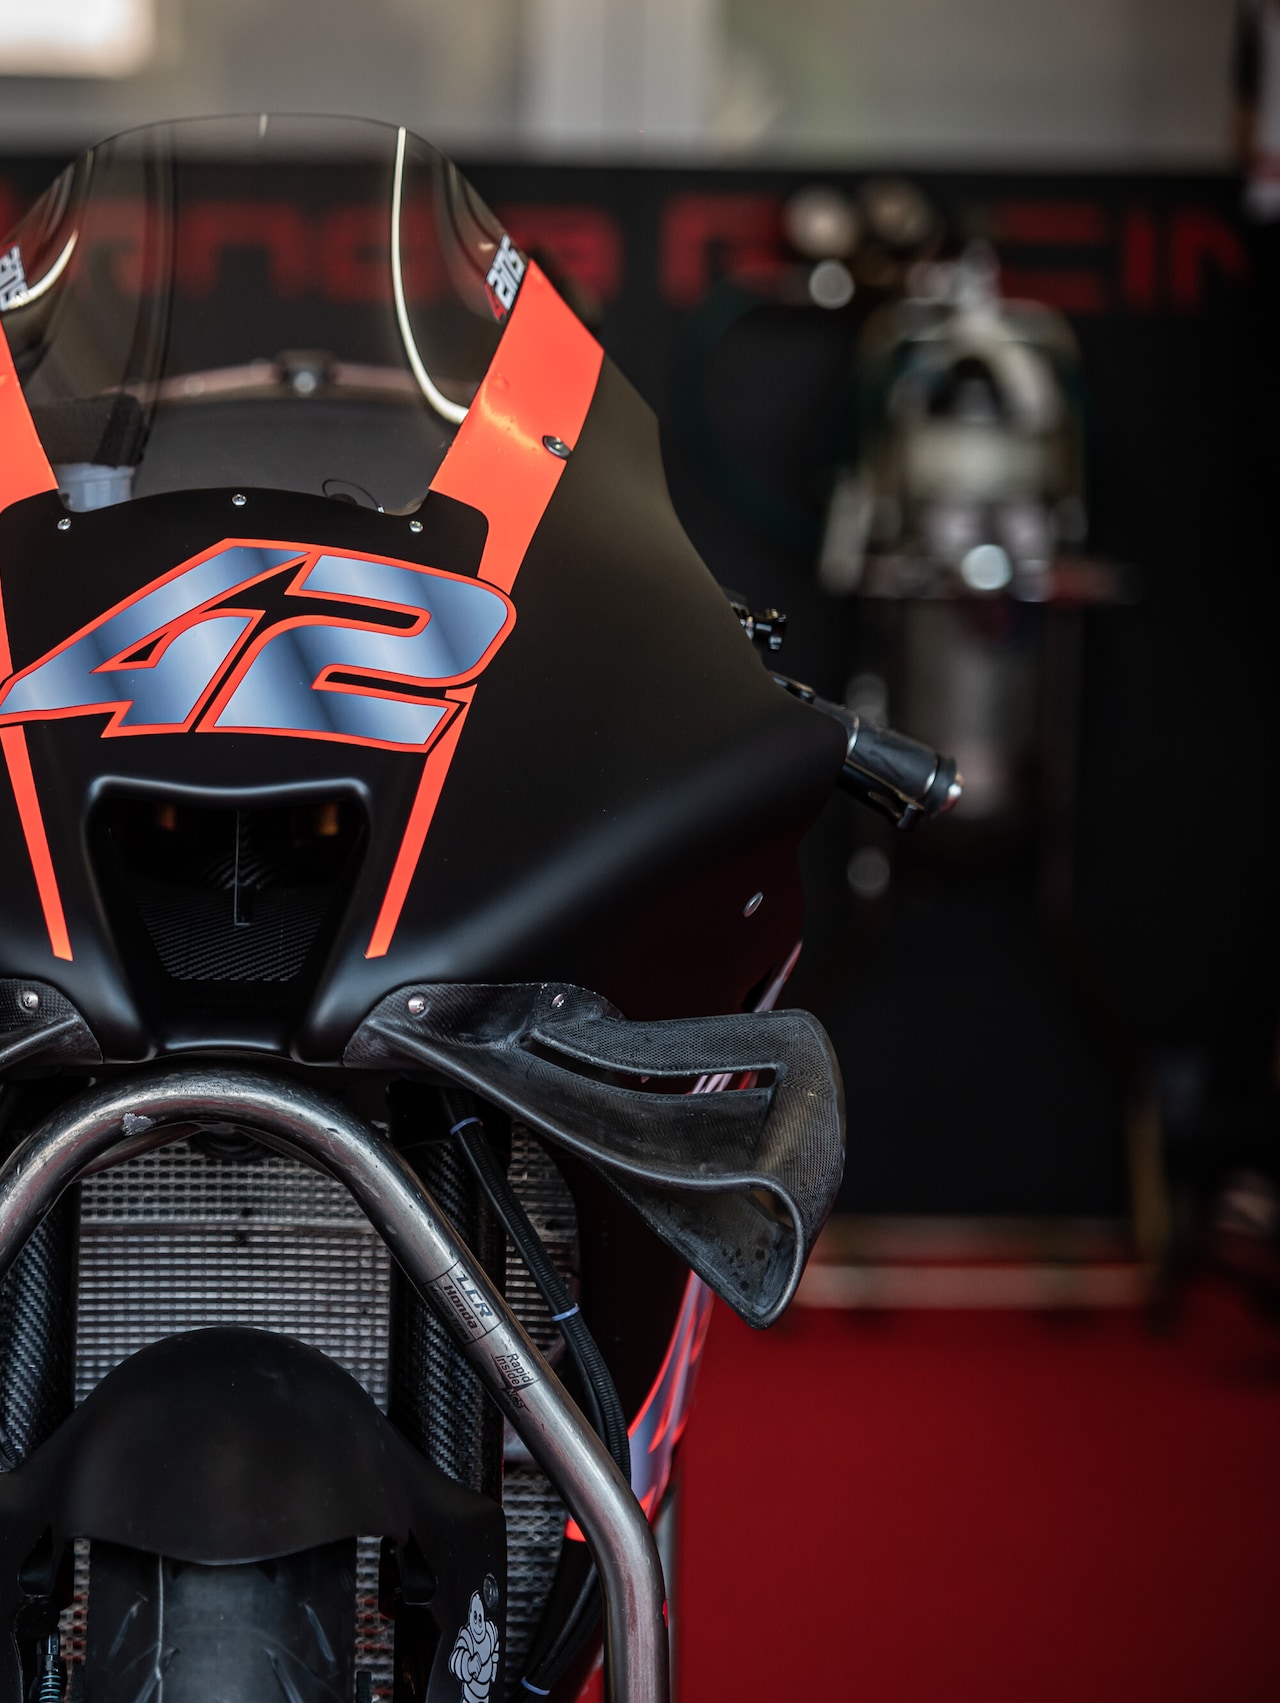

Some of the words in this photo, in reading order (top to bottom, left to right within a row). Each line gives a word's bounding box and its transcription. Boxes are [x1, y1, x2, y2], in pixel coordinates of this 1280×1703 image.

[444, 1285, 478, 1329] Honda
[456, 1276, 493, 1318] LCR
[495, 1355, 520, 1387] Inside
[507, 1353, 534, 1383] Rapid
